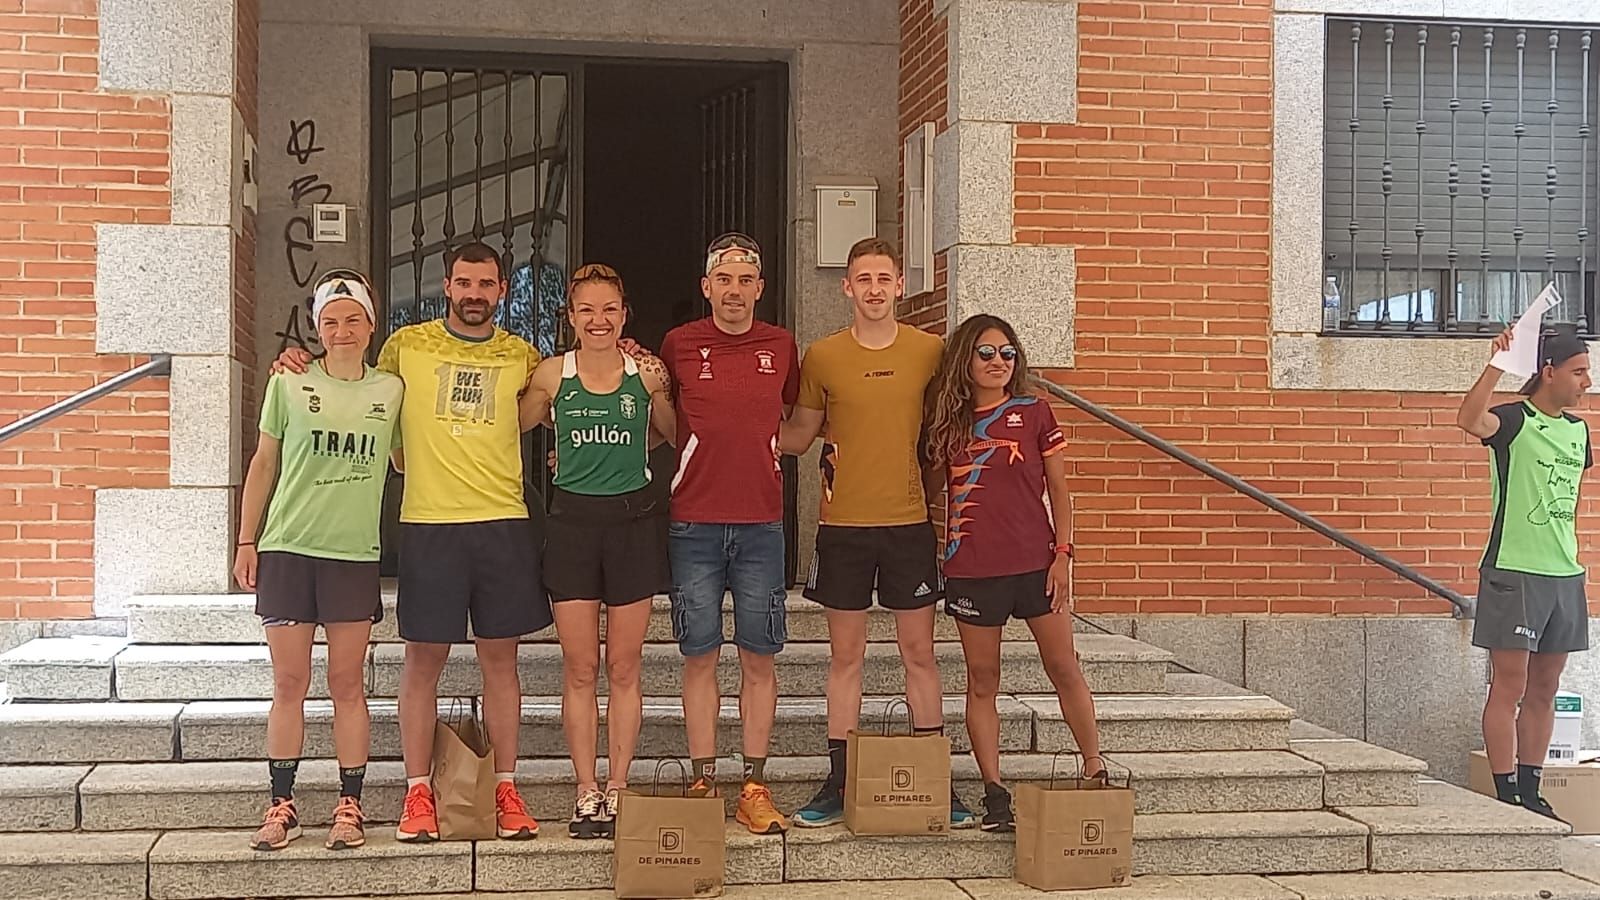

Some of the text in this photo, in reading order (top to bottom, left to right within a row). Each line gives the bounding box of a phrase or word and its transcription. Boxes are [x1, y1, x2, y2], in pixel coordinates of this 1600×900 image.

[456, 371, 482, 387] WE
[451, 387, 483, 403] RUN
[312, 430, 375, 456] TRAIL
[571, 424, 631, 448] gullón
[873, 794, 932, 803] DE PINARES
[1063, 847, 1118, 857] DE PINARES
[638, 856, 701, 865] DE PINARES
